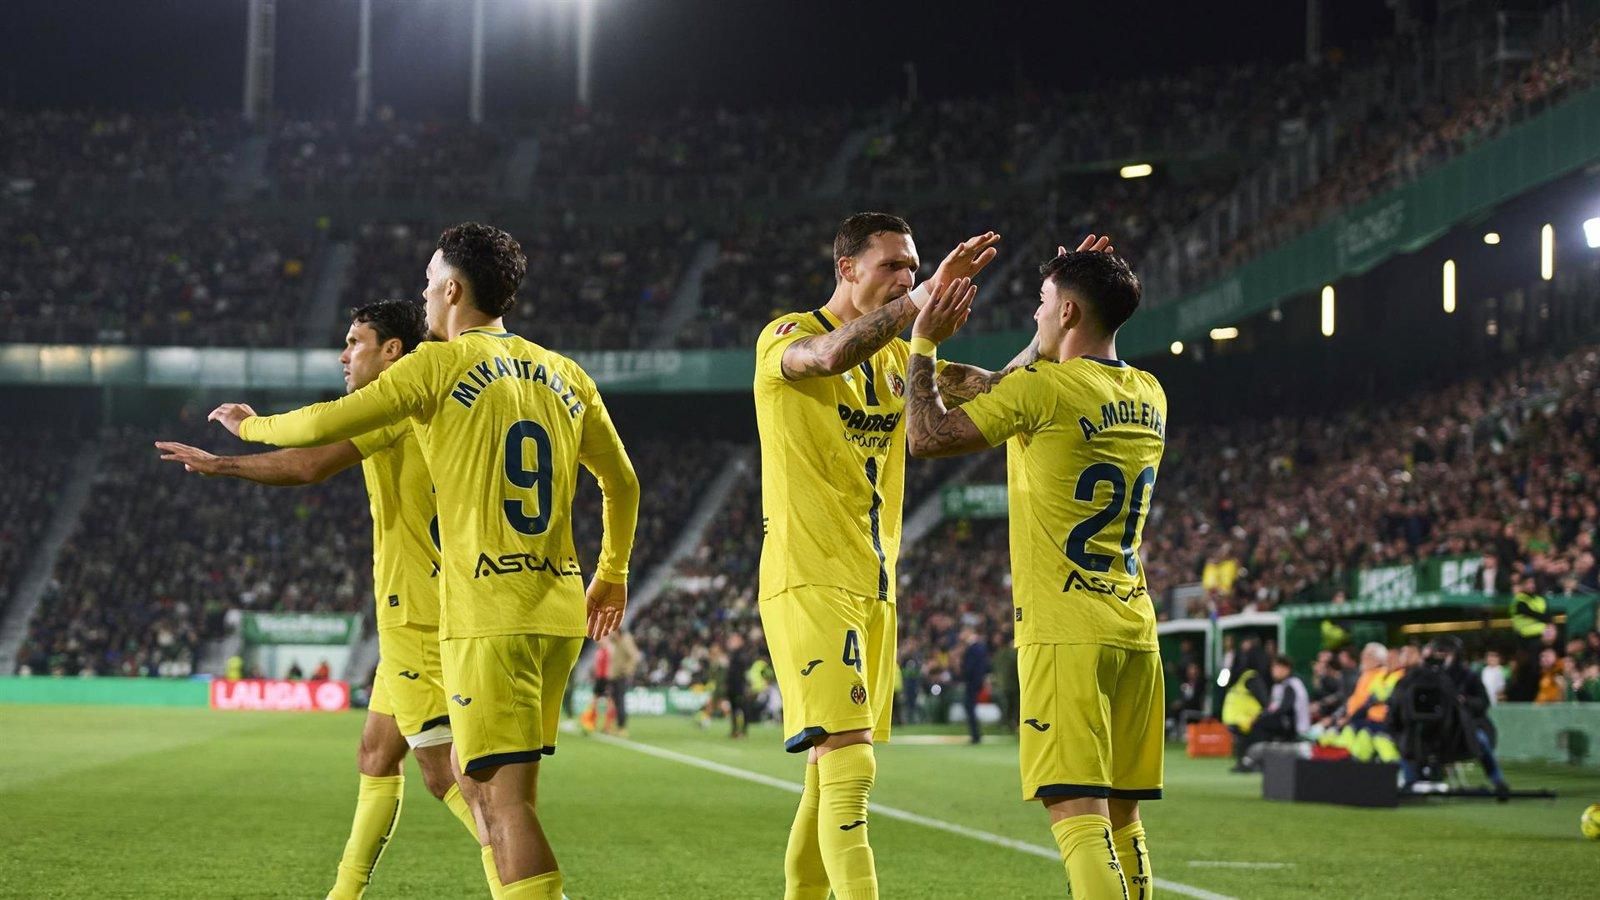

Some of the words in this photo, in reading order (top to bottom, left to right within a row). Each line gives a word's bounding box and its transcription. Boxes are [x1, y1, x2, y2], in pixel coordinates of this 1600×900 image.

[451, 357, 584, 419] MIKAUTADZE
[503, 419, 553, 536] 9
[1064, 462, 1155, 577] 20
[842, 629, 862, 673] 4
[214, 681, 314, 710] LALIGA
